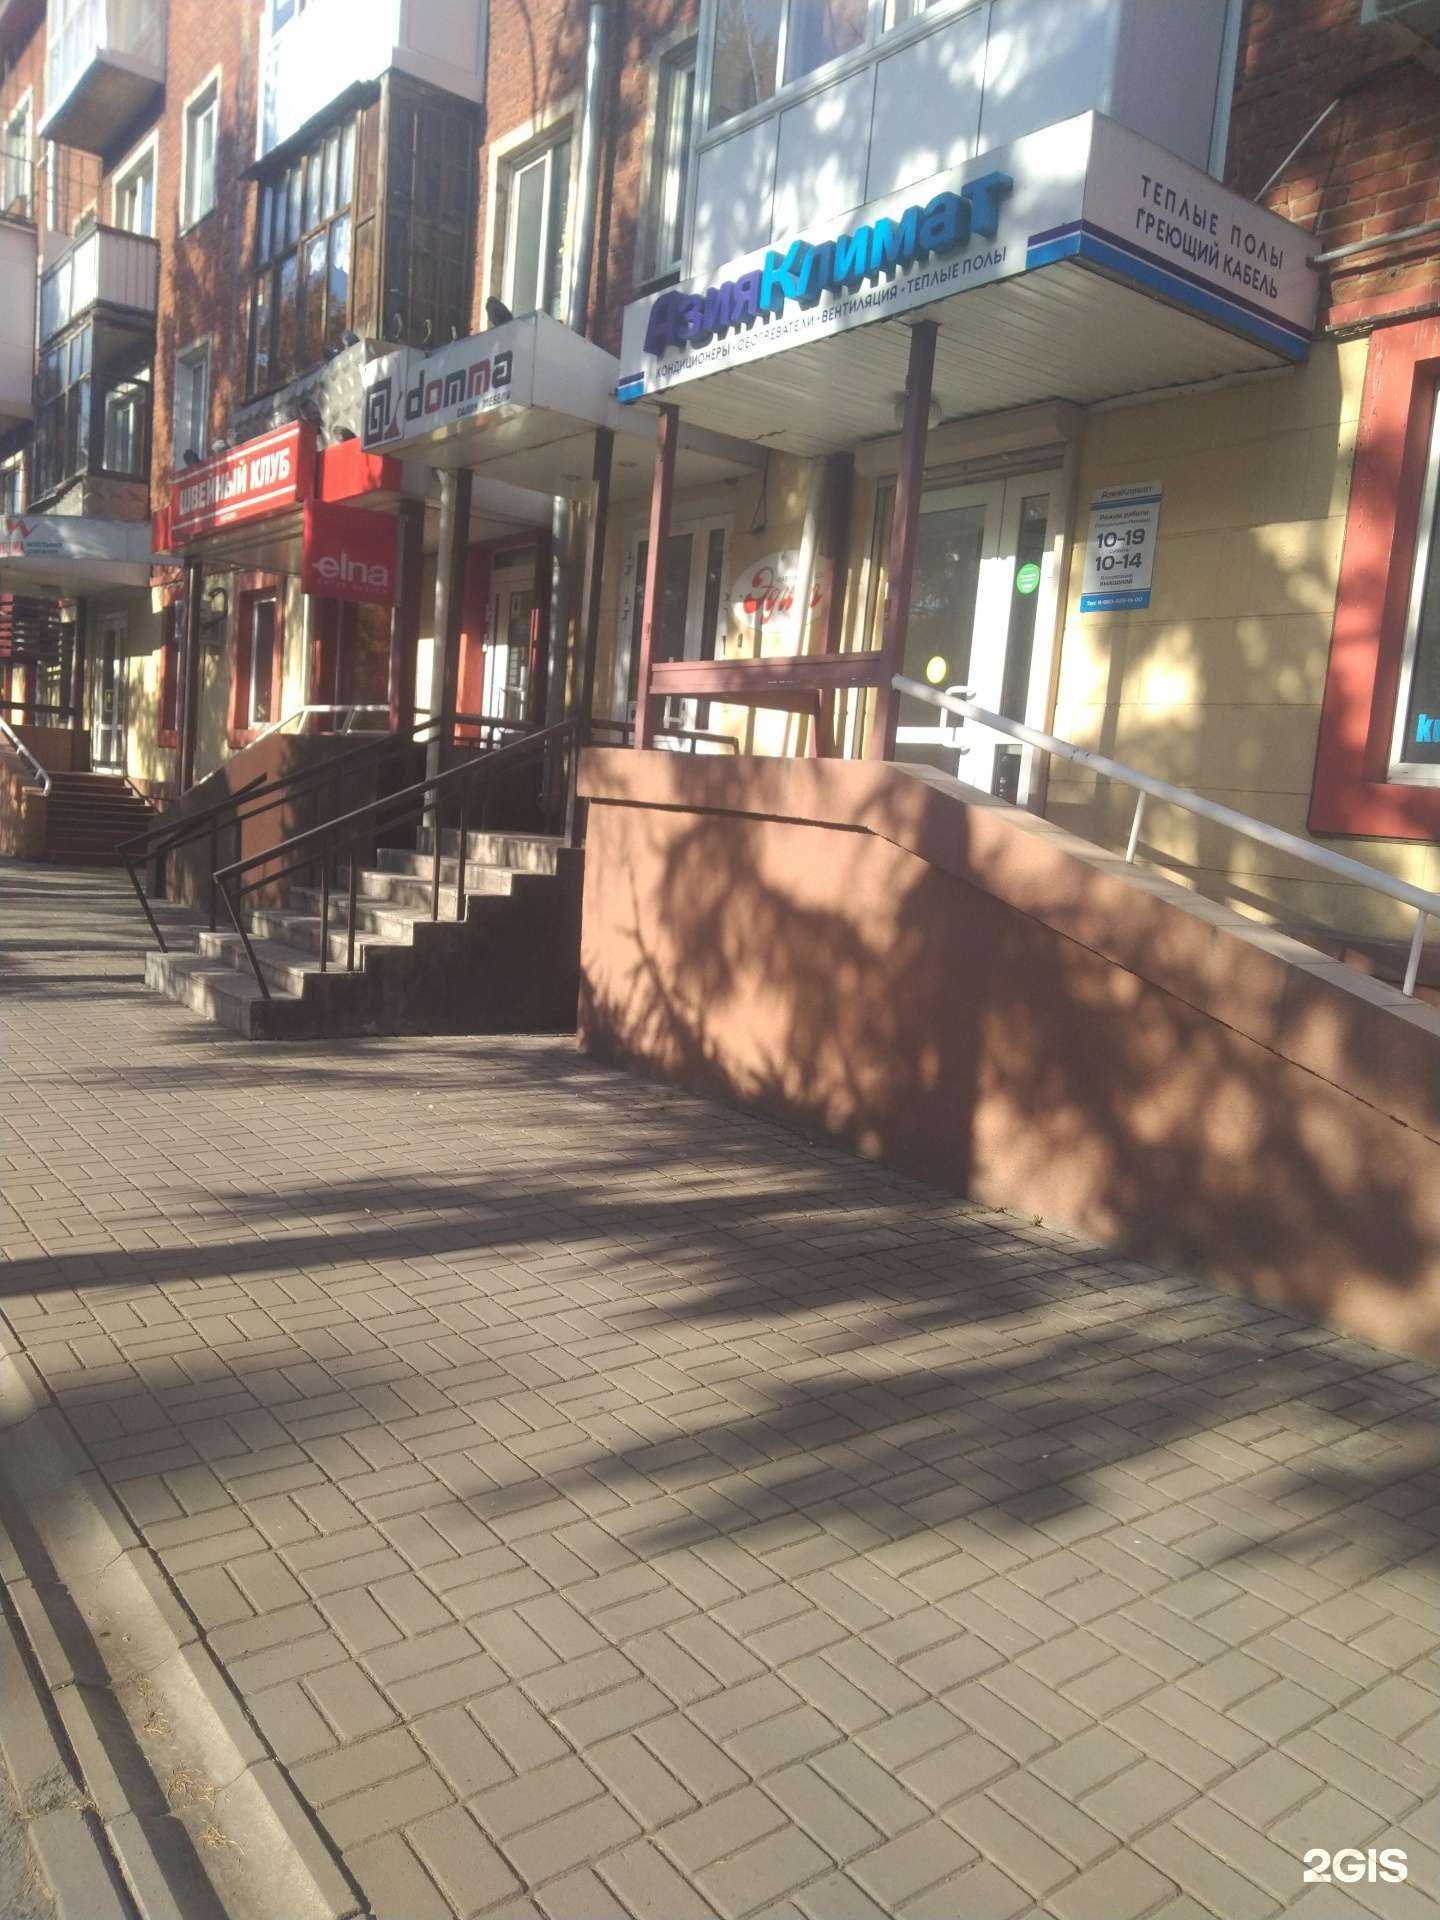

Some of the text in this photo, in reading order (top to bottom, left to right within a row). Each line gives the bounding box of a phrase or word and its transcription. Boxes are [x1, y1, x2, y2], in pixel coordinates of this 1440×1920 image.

[1136, 207, 1279, 299] ГРЕЮЩИЙ КАБЕЛЬ
[1141, 174, 1284, 270] ТЕПЛЫЕ ПОЛЫ
[656, 246, 1007, 377] КОНДИЦИОНЕРЫ ОБОГРЕВАТЕЛИ ВЕНТИЛЯЦИЯ ТЕПЛЫЕ ПОЛЫ
[180, 447, 291, 516] ШВЕЙНЫЙ КЛУБ
[312, 553, 389, 588] elna
[1095, 552, 1142, 572] 10-14
[1097, 528, 1146, 549] 10-19
